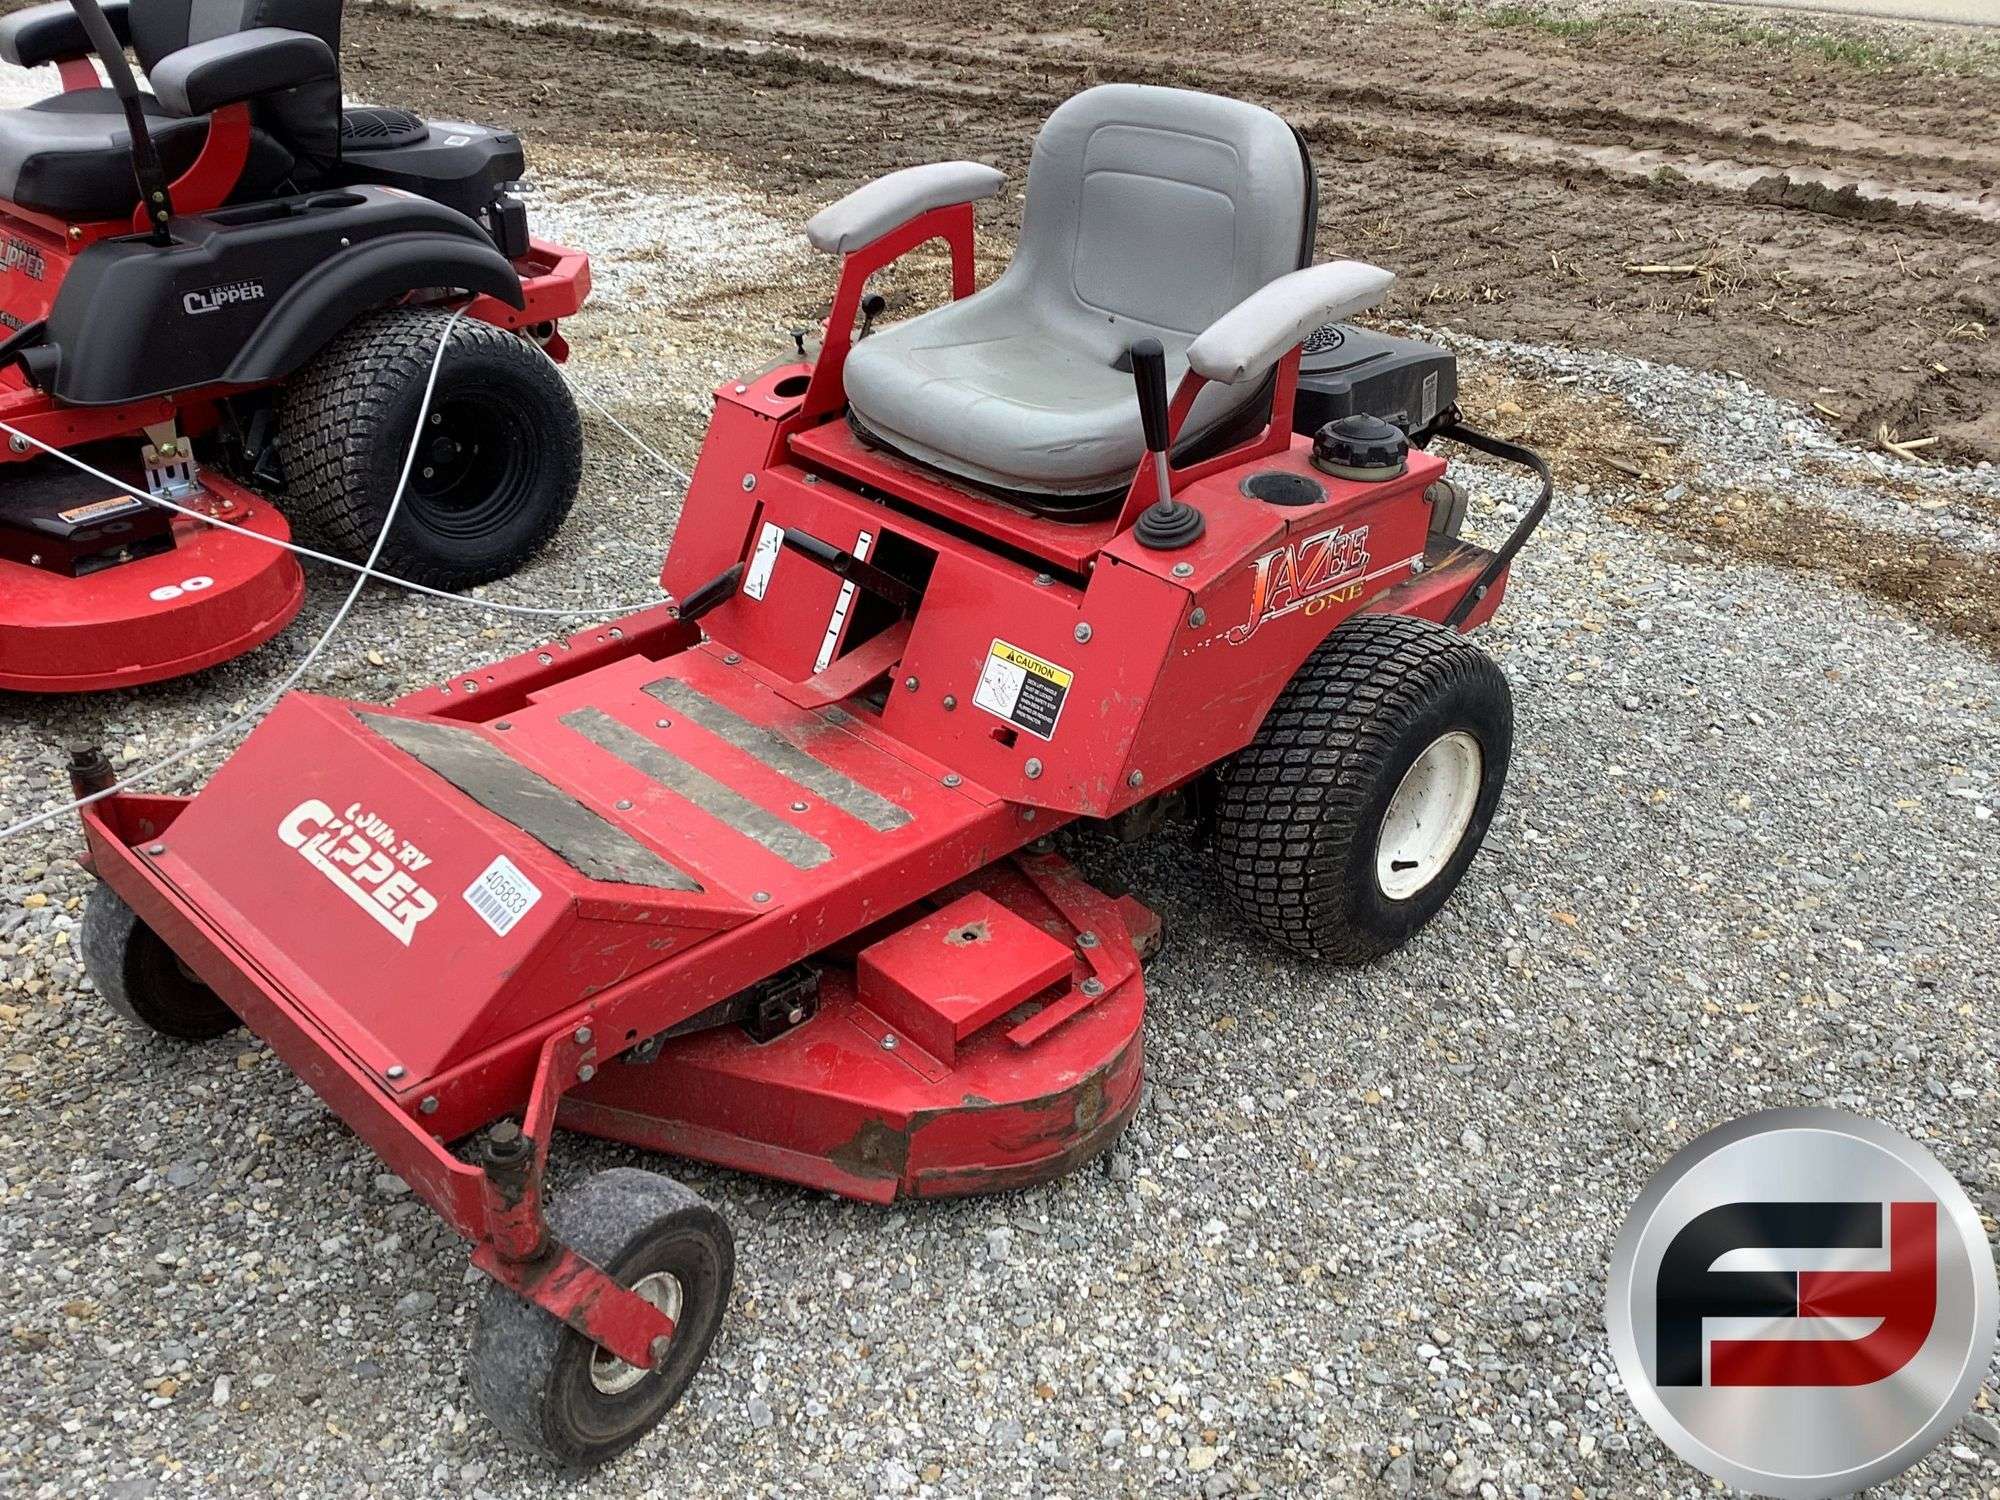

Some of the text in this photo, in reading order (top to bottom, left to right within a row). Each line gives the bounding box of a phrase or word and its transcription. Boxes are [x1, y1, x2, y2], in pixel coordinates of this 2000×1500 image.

[0, 241, 45, 281] LIPPER
[183, 285, 264, 315] CLIPPER
[149, 575, 214, 601] 60
[1305, 582, 1364, 616] ONE
[1015, 655, 1055, 679] CAUTION
[486, 871, 527, 914] 405833
